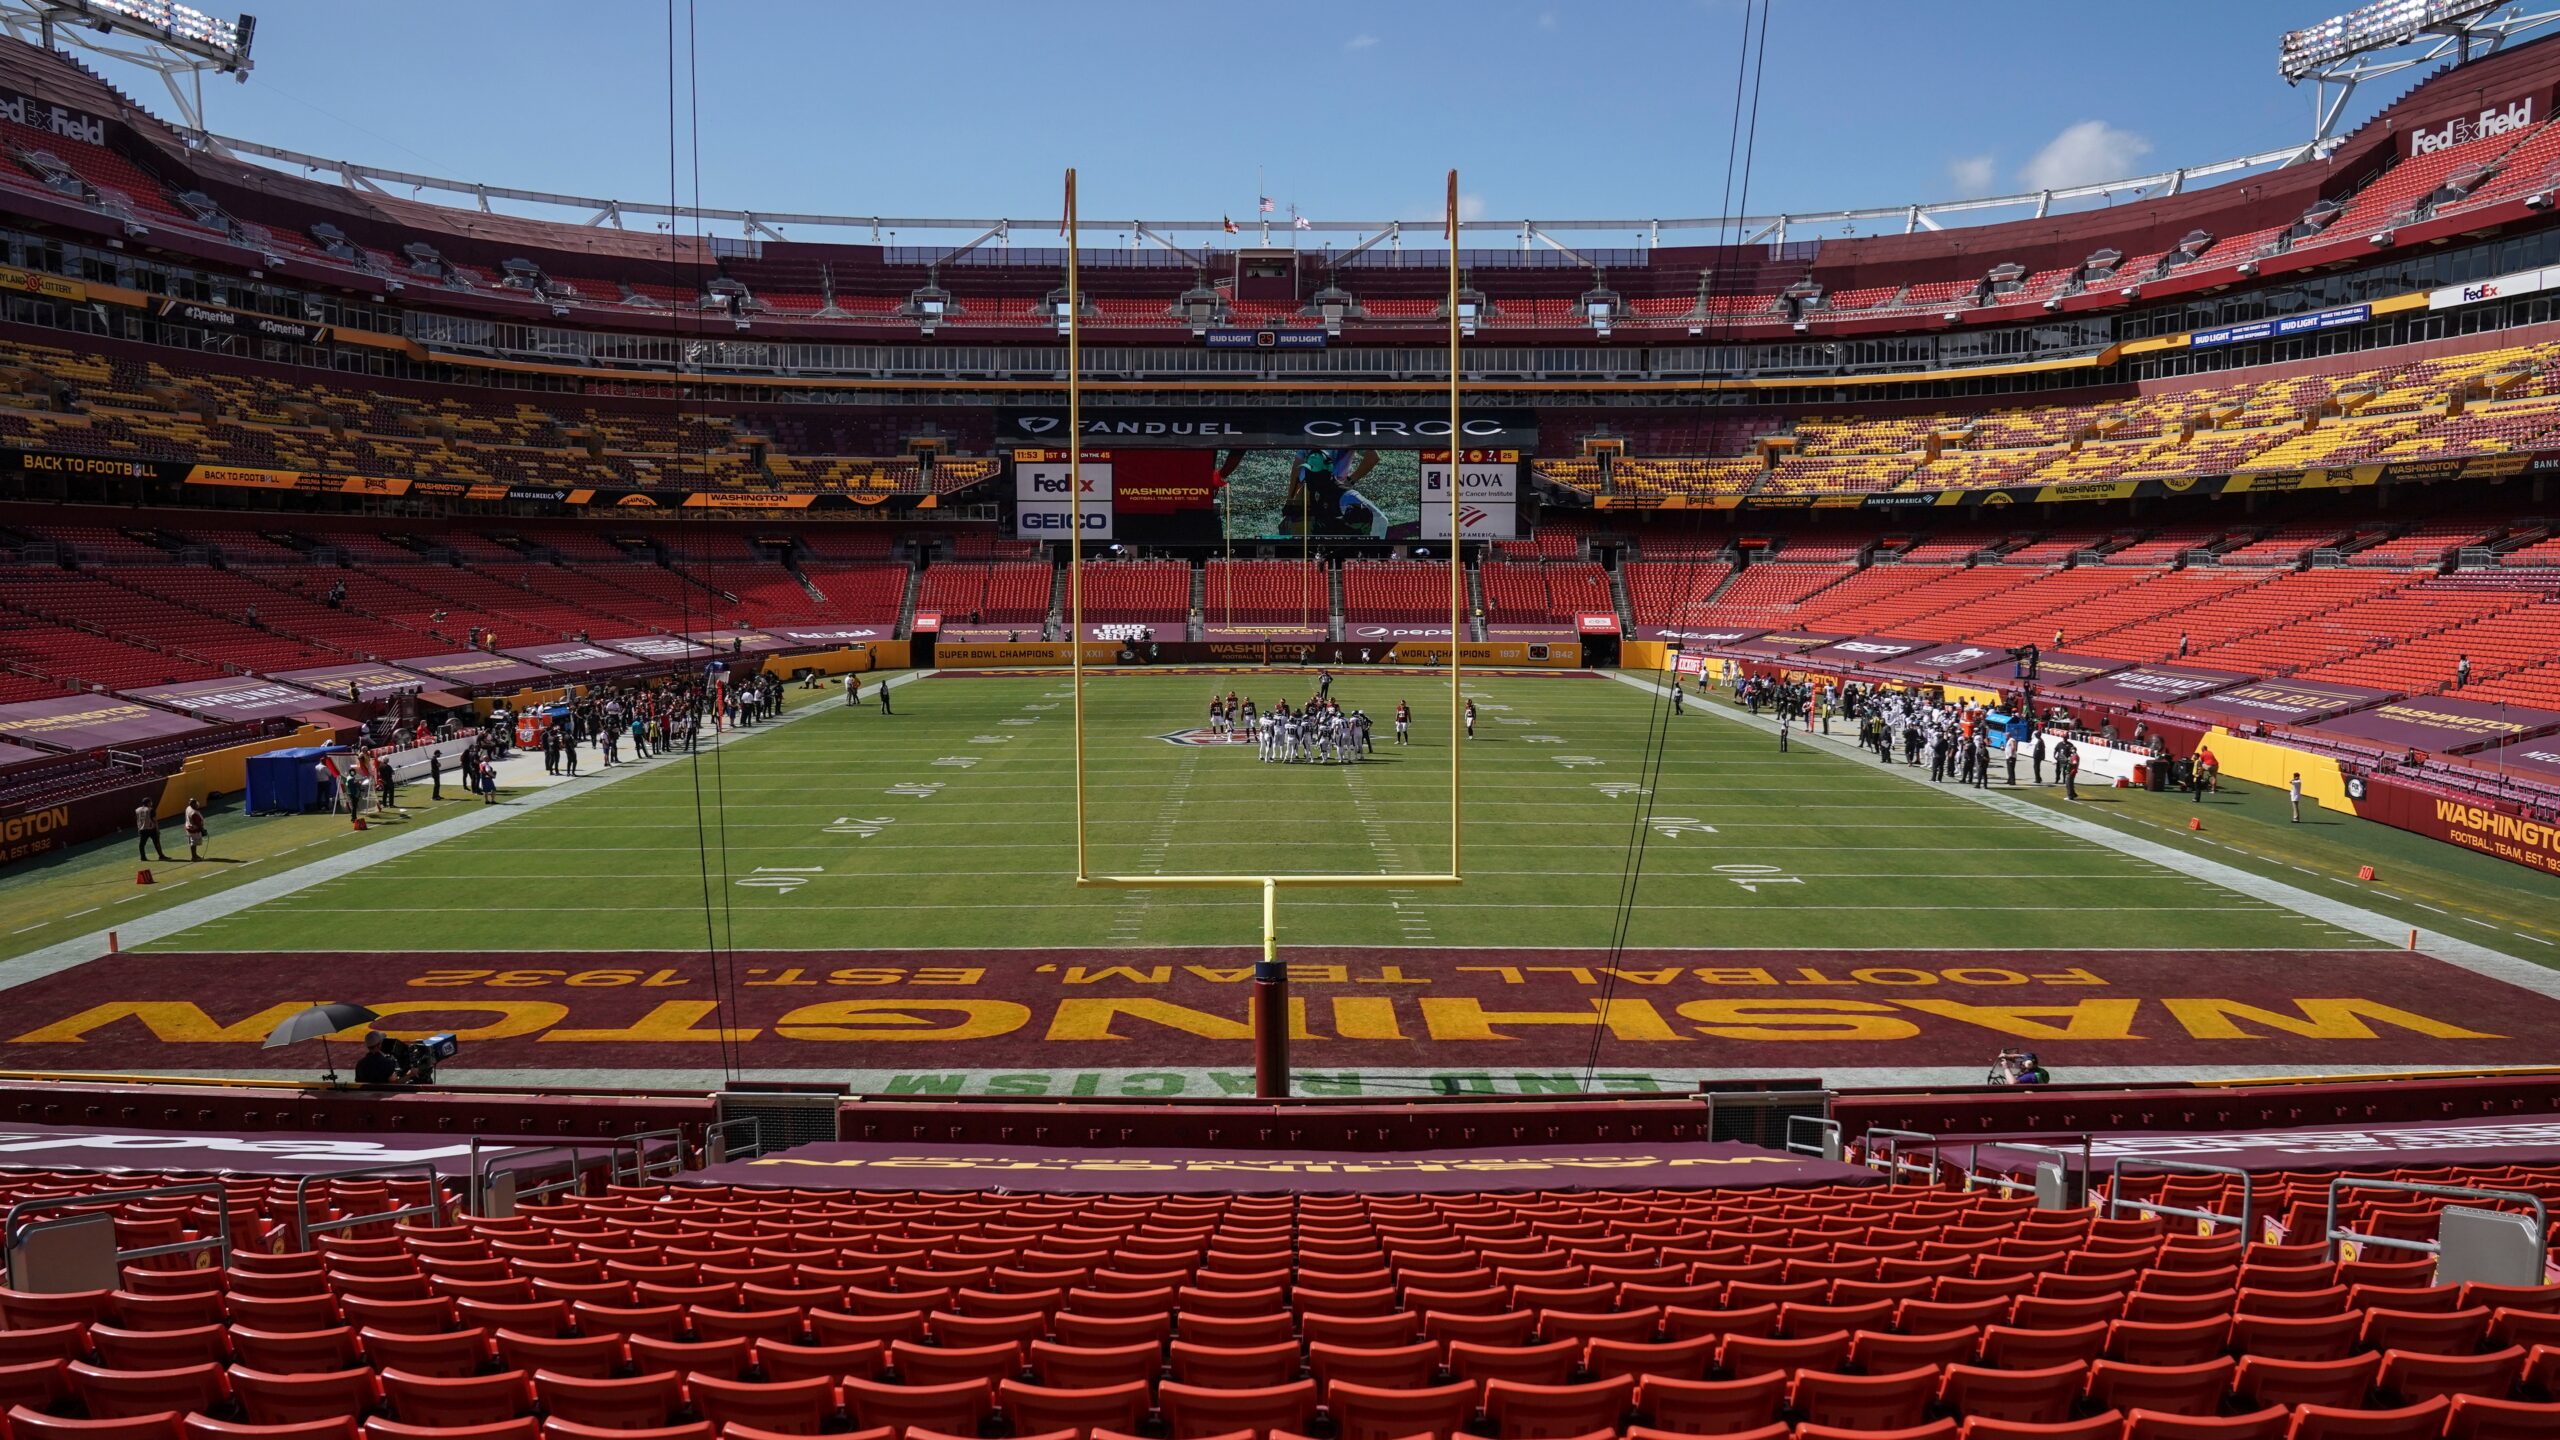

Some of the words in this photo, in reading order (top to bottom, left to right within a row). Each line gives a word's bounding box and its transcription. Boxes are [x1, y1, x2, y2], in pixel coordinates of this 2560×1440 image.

[2411, 97, 2532, 157] FedExField
[41, 281, 72, 295] LOTTERY
[2464, 284, 2497, 301] FedEx
[194, 307, 235, 324] Ameritel
[2281, 320, 2297, 330] BUD
[2297, 317, 2318, 328] LIGHT
[266, 320, 305, 336] Ameritel
[1281, 335, 1298, 343] BUD
[1298, 335, 1322, 343] LIGHT
[2195, 334, 2209, 344] BUD
[2209, 332, 2230, 342] LIGHT
[23, 454, 62, 471] BACK
[66, 458, 85, 472] TO
[1016, 451, 1038, 459] 11:53
[2388, 461, 2459, 474] WASHINGTON
[2534, 460, 2559, 469] BANK
[204, 471, 225, 480] BACK
[228, 472, 237, 480] TO
[414, 482, 465, 492] WASHINGTON
[1119, 487, 1209, 495] WASHINGTON
[2055, 484, 2115, 494] WASHINGTON
[711, 494, 788, 502] WASHINGTON
[1022, 513, 1107, 529] GEICO
[1393, 628, 1462, 637] peps
[939, 650, 968, 659] SUPER
[971, 650, 998, 659] BOWL
[1000, 650, 1055, 658] CHAMPIONS
[2107, 672, 2220, 690] BURGUNDY
[168, 685, 298, 709] BURGUNDY
[2226, 688, 2284, 700] AND
[2275, 695, 2349, 709] GOLD
[2376, 705, 2533, 733] WASHINGTON
[0, 805, 69, 842] GTON
[821, 816, 896, 833] 20
[1640, 816, 1719, 833] 20
[11, 844, 28, 859] EST.
[31, 838, 52, 854] 1932
[2450, 829, 2494, 852] FOOTBALL
[2494, 841, 2523, 862] TEAM,
[2526, 851, 2544, 867] EST.
[734, 865, 825, 887] 10
[1711, 864, 1806, 885] 10
[2361, 867, 2373, 877] 10
[406, 968, 693, 988] 1932
[746, 967, 984, 987] EST.
[1036, 966, 1431, 987] TEAM,
[1456, 966, 2108, 987] FOOTBALL
[8, 996, 2513, 1044] WASHINGTON
[883, 1072, 1361, 1097] RACISM
[1430, 1073, 1658, 1095] END
[746, 1156, 1806, 1173] WASHINGTON
